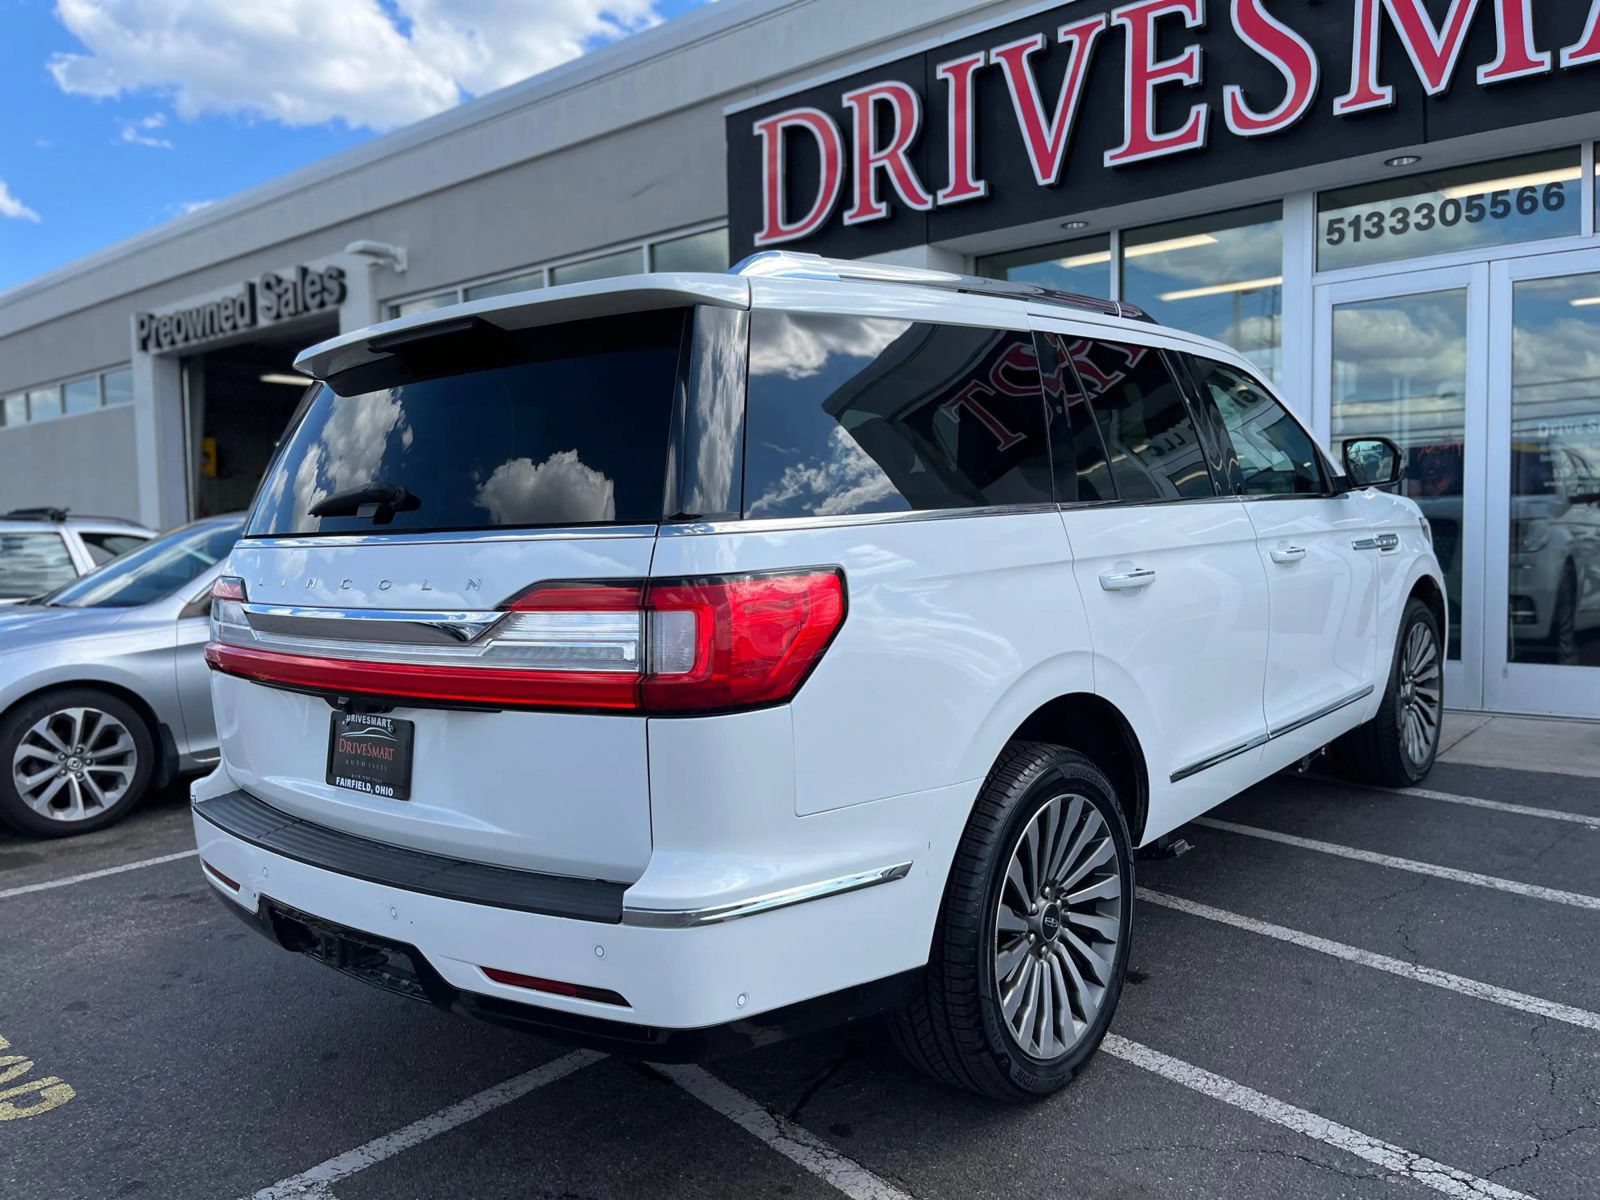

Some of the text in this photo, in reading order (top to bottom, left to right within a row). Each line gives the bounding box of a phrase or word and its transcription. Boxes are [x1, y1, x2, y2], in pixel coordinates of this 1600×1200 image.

[1326, 182, 1565, 245] 5133305566
[136, 265, 347, 351] Preowned Sales
[258, 578, 482, 592] LINCOLN
[375, 784, 394, 797] OHIO
